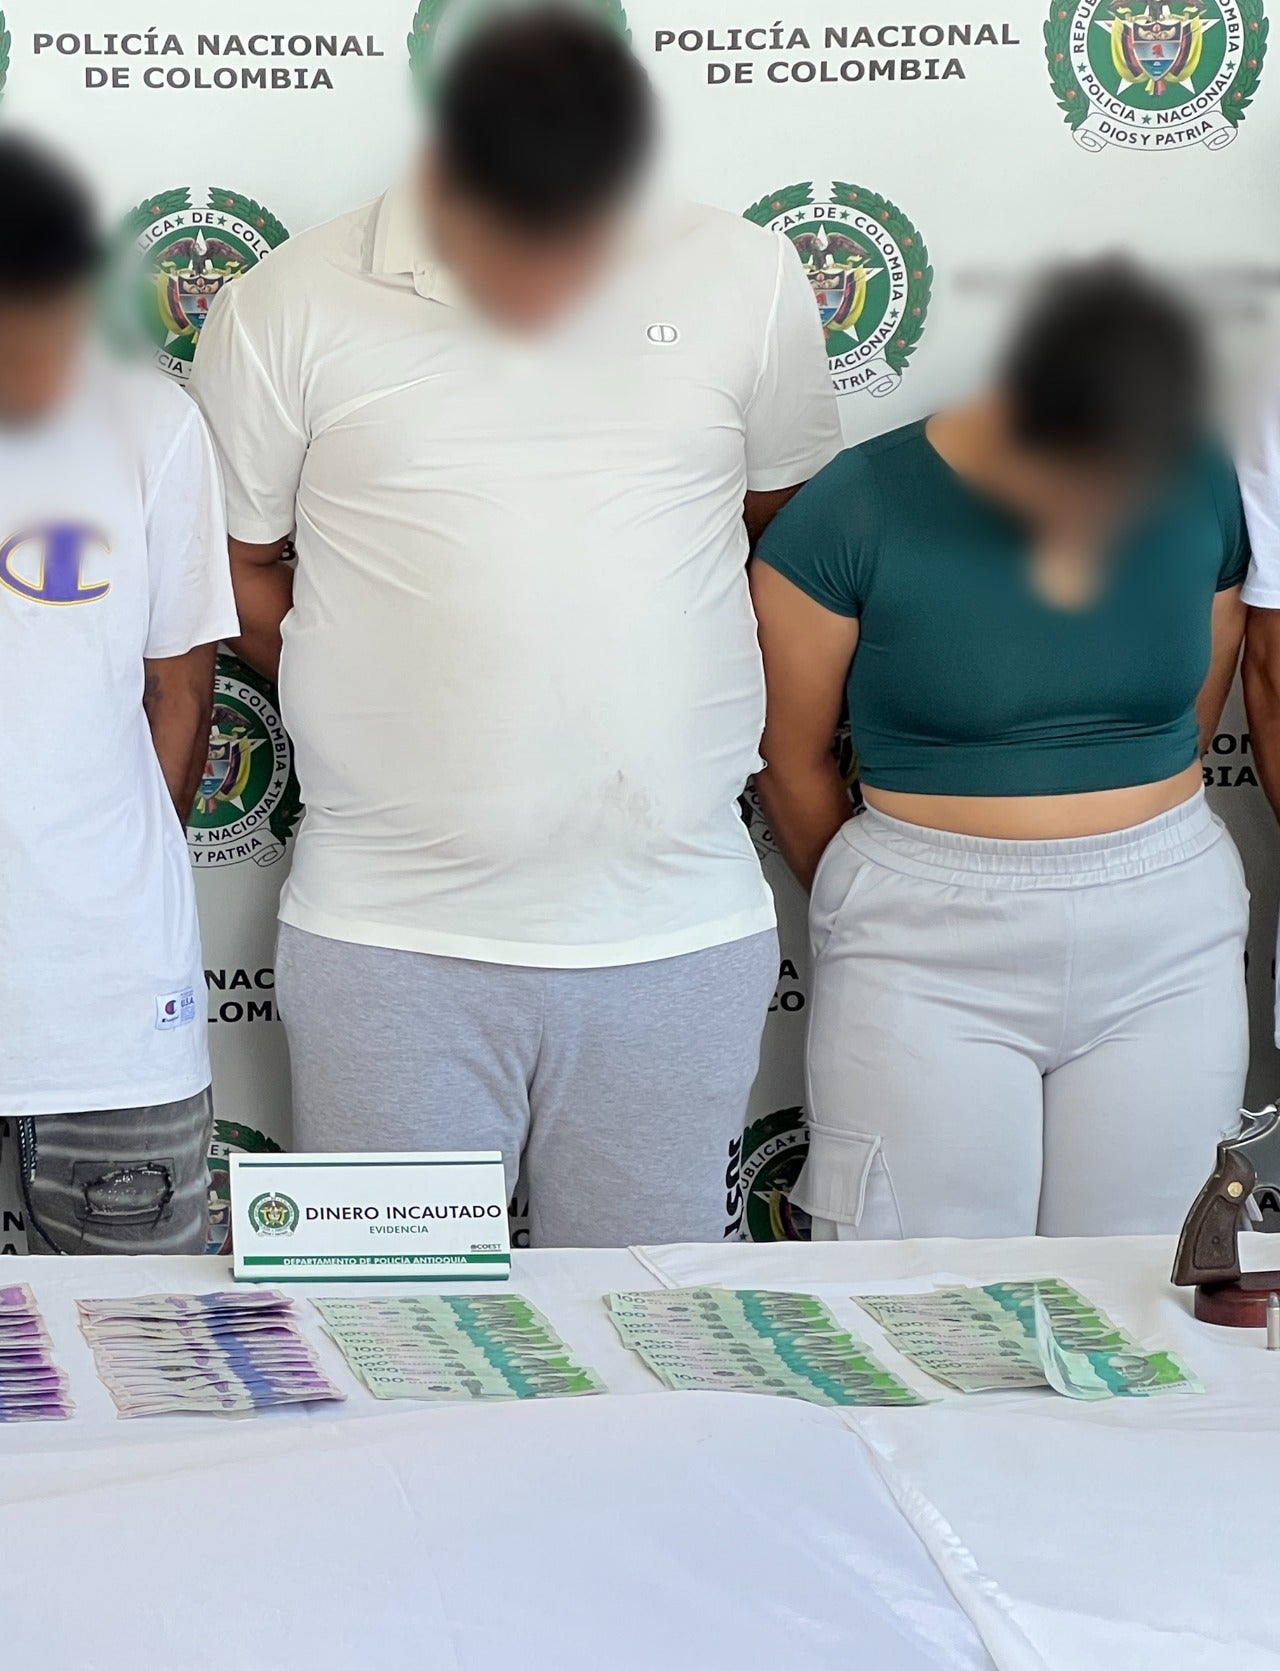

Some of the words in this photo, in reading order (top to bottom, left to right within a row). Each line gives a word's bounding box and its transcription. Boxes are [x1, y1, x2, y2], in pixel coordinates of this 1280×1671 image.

[654, 20, 811, 53] POLICÍA
[823, 22, 1020, 49] NACIONAL
[1219, 0, 1240, 53] OMBIA
[33, 26, 185, 55] POLICÍA
[197, 33, 385, 57] NACIONAL
[84, 66, 131, 89] DE
[142, 66, 335, 89] COLOMBIA
[706, 62, 754, 84] DE
[766, 58, 966, 84] COLOMBIA
[1156, 72, 1232, 125] NACIONAL
[1098, 120, 1138, 144] DIOS
[1139, 133, 1151, 146] Y
[1155, 120, 1213, 146] PATRIA
[191, 212, 215, 224] DE
[813, 207, 837, 219] DE
[854, 216, 904, 302] COLOMBIA
[238, 687, 288, 772] COLOMBIA
[208, 789, 280, 842] NACIONAL
[193, 851, 203, 863] Y
[208, 837, 262, 863] PATRIA
[305, 1206, 380, 1221] DINERO
[386, 1204, 502, 1219] INCAUTADO
[369, 1225, 429, 1234] EVIDENCIA
[283, 1256, 357, 1265] DEPARTAMENTO
[359, 1257, 372, 1265] DE
[374, 1255, 411, 1265] POLICÍA
[672, 1373, 705, 1382] 100
[930, 1362, 962, 1370] 100
